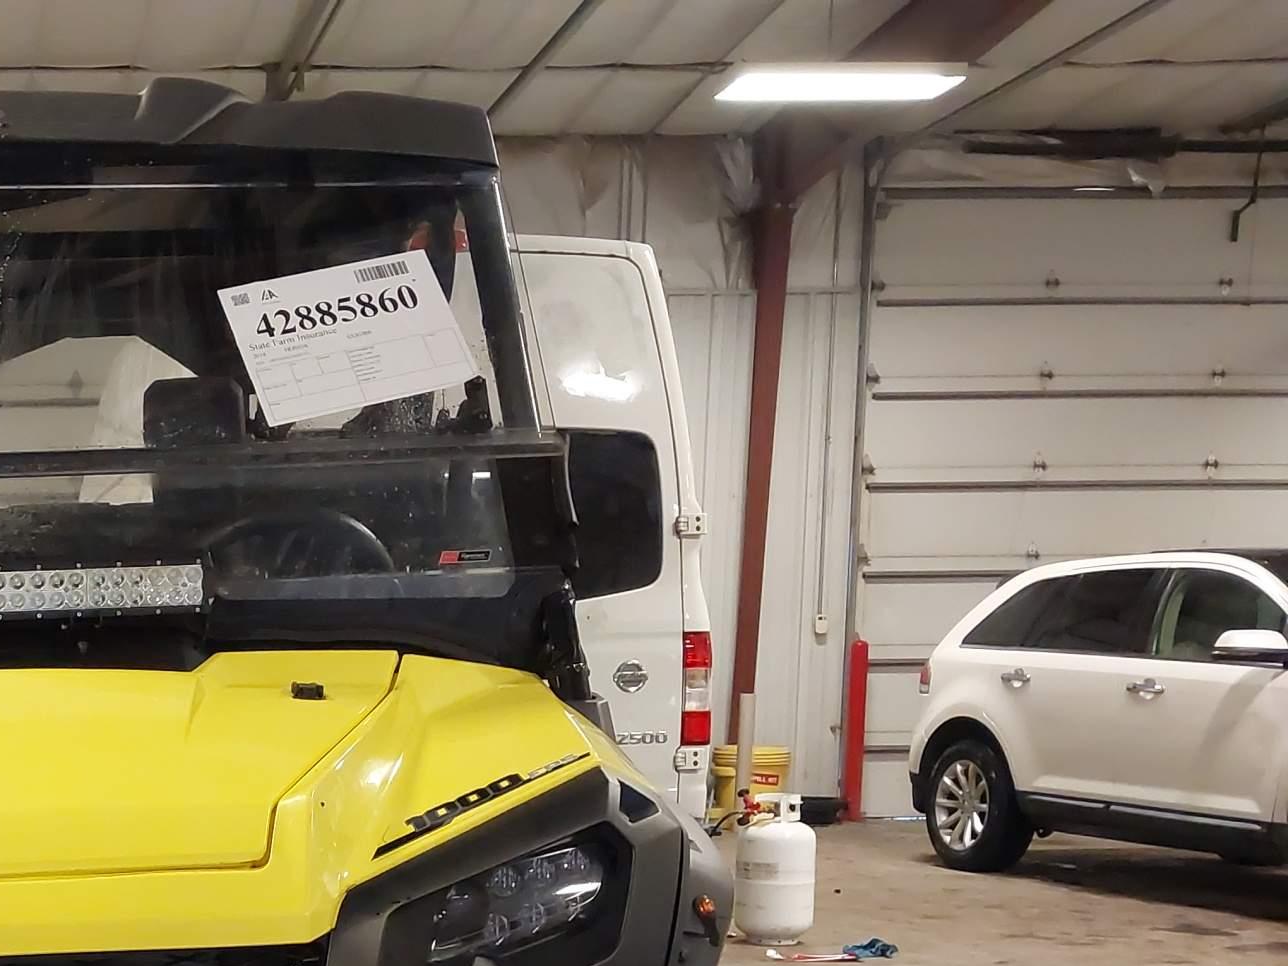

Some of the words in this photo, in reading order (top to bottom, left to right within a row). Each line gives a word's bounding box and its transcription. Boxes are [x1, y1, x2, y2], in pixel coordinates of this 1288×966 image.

[256, 284, 418, 337] 42885860
[248, 341, 270, 352] State
[272, 337, 295, 347] Farm
[296, 328, 337, 341] Insurance
[617, 730, 668, 746] 2500
[404, 773, 525, 832] 1000
